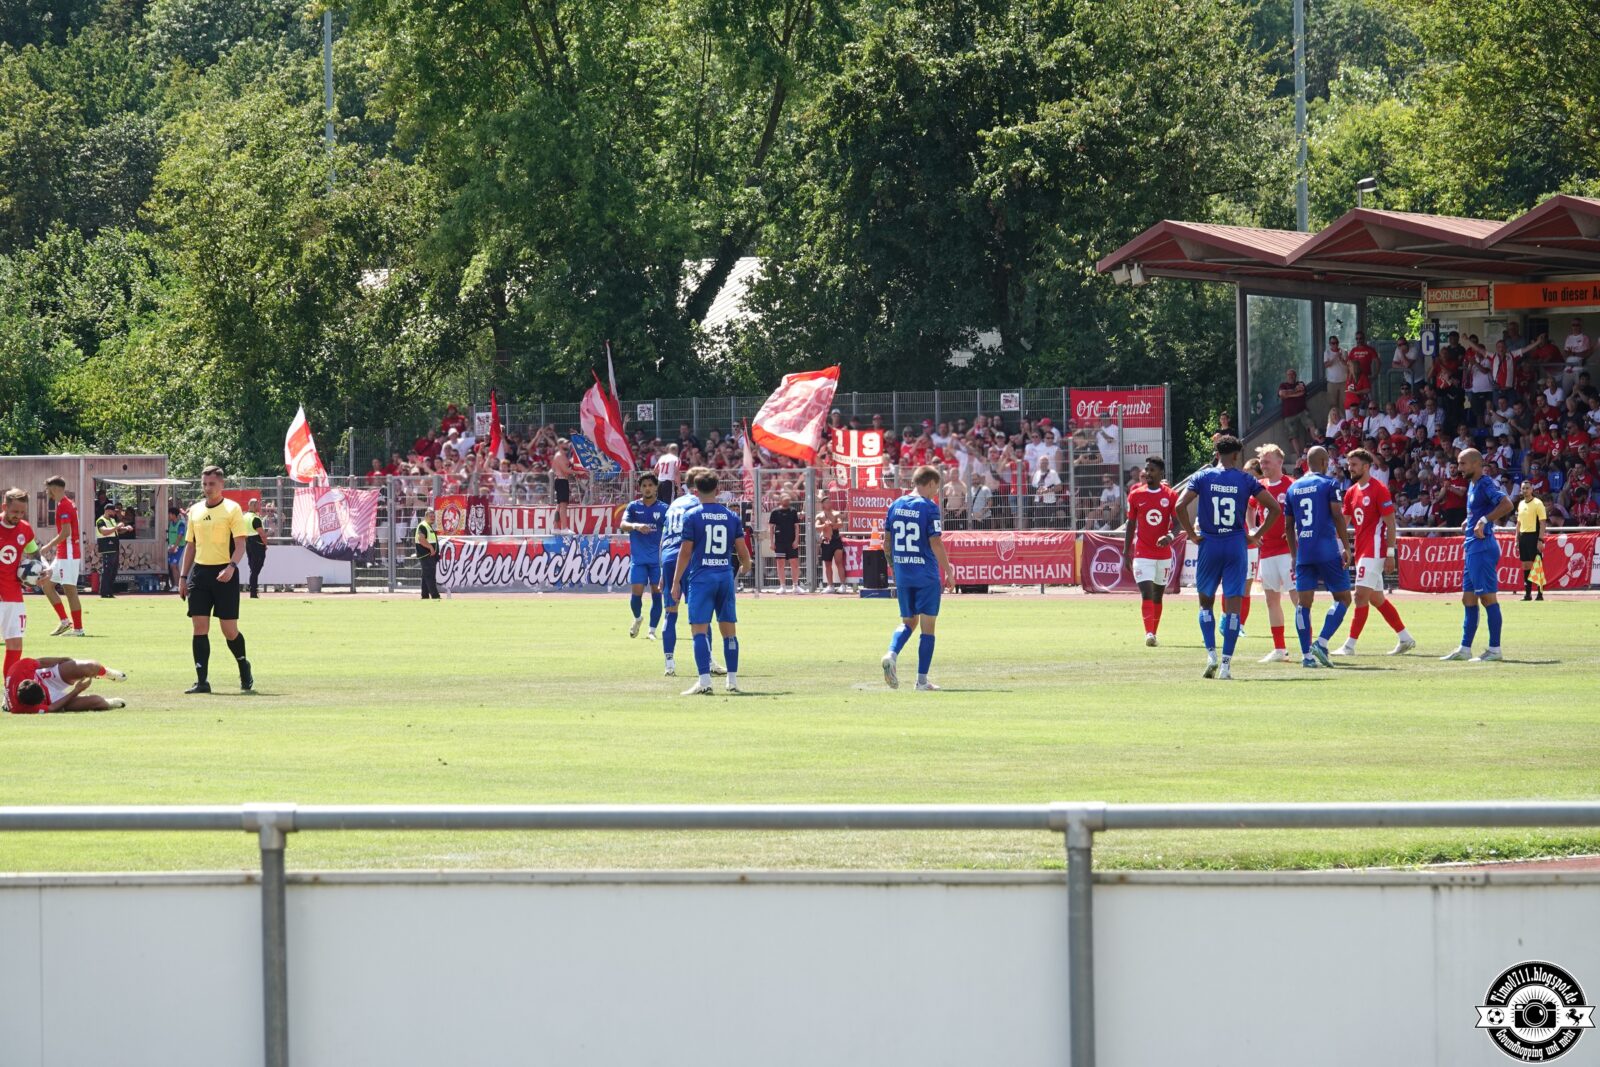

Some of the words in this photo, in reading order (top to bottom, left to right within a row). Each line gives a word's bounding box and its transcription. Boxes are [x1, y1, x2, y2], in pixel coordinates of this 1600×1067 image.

[1428, 289, 1478, 301] HORNBACH
[1542, 288, 1558, 302] Von
[1561, 287, 1588, 301] dieser
[1421, 331, 1435, 356] C
[862, 432, 880, 456] 9
[660, 462, 669, 474] 71
[1210, 483, 1238, 494] FREIBERG
[852, 496, 893, 508] HORRIDO
[701, 512, 728, 521] FREIBERG
[894, 508, 920, 519] FREIBERG
[1212, 496, 1236, 527] 13
[1299, 498, 1313, 527] 3
[490, 507, 587, 535] KOLLEKIV
[591, 507, 613, 535] 71
[704, 524, 728, 555] 19
[892, 520, 921, 552] 22
[954, 537, 994, 547] KICKERS
[1017, 536, 1064, 547] SUPPORT
[1400, 544, 1421, 563] DA
[436, 538, 585, 589] Offenbach
[702, 558, 728, 566] ALBERICO
[1095, 561, 1119, 574] O.F.C.
[1358, 566, 1366, 578] 9
